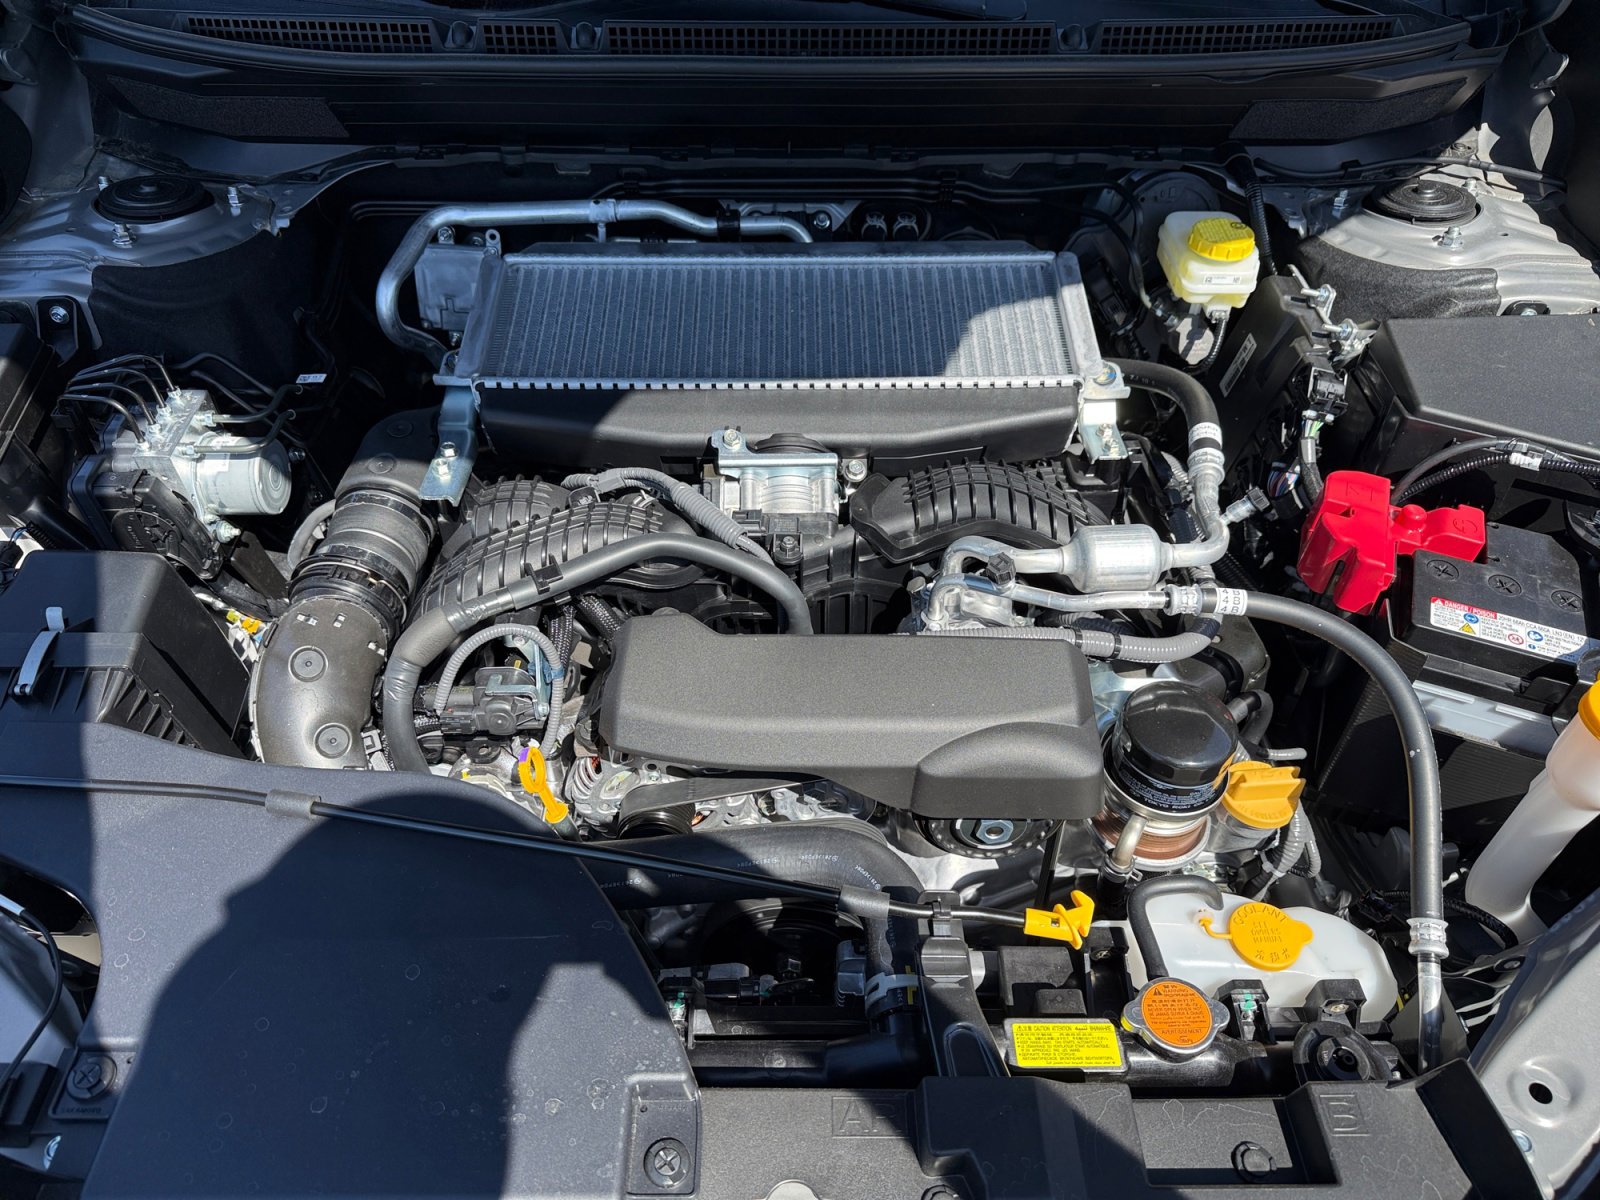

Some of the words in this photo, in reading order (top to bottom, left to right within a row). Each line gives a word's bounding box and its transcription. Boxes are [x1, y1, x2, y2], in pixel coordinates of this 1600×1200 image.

[1444, 600, 1469, 612] DANGER
[1472, 608, 1495, 618] POISON
[1144, 797, 1170, 808] TOKYO
[1232, 904, 1288, 925] COOLANT
